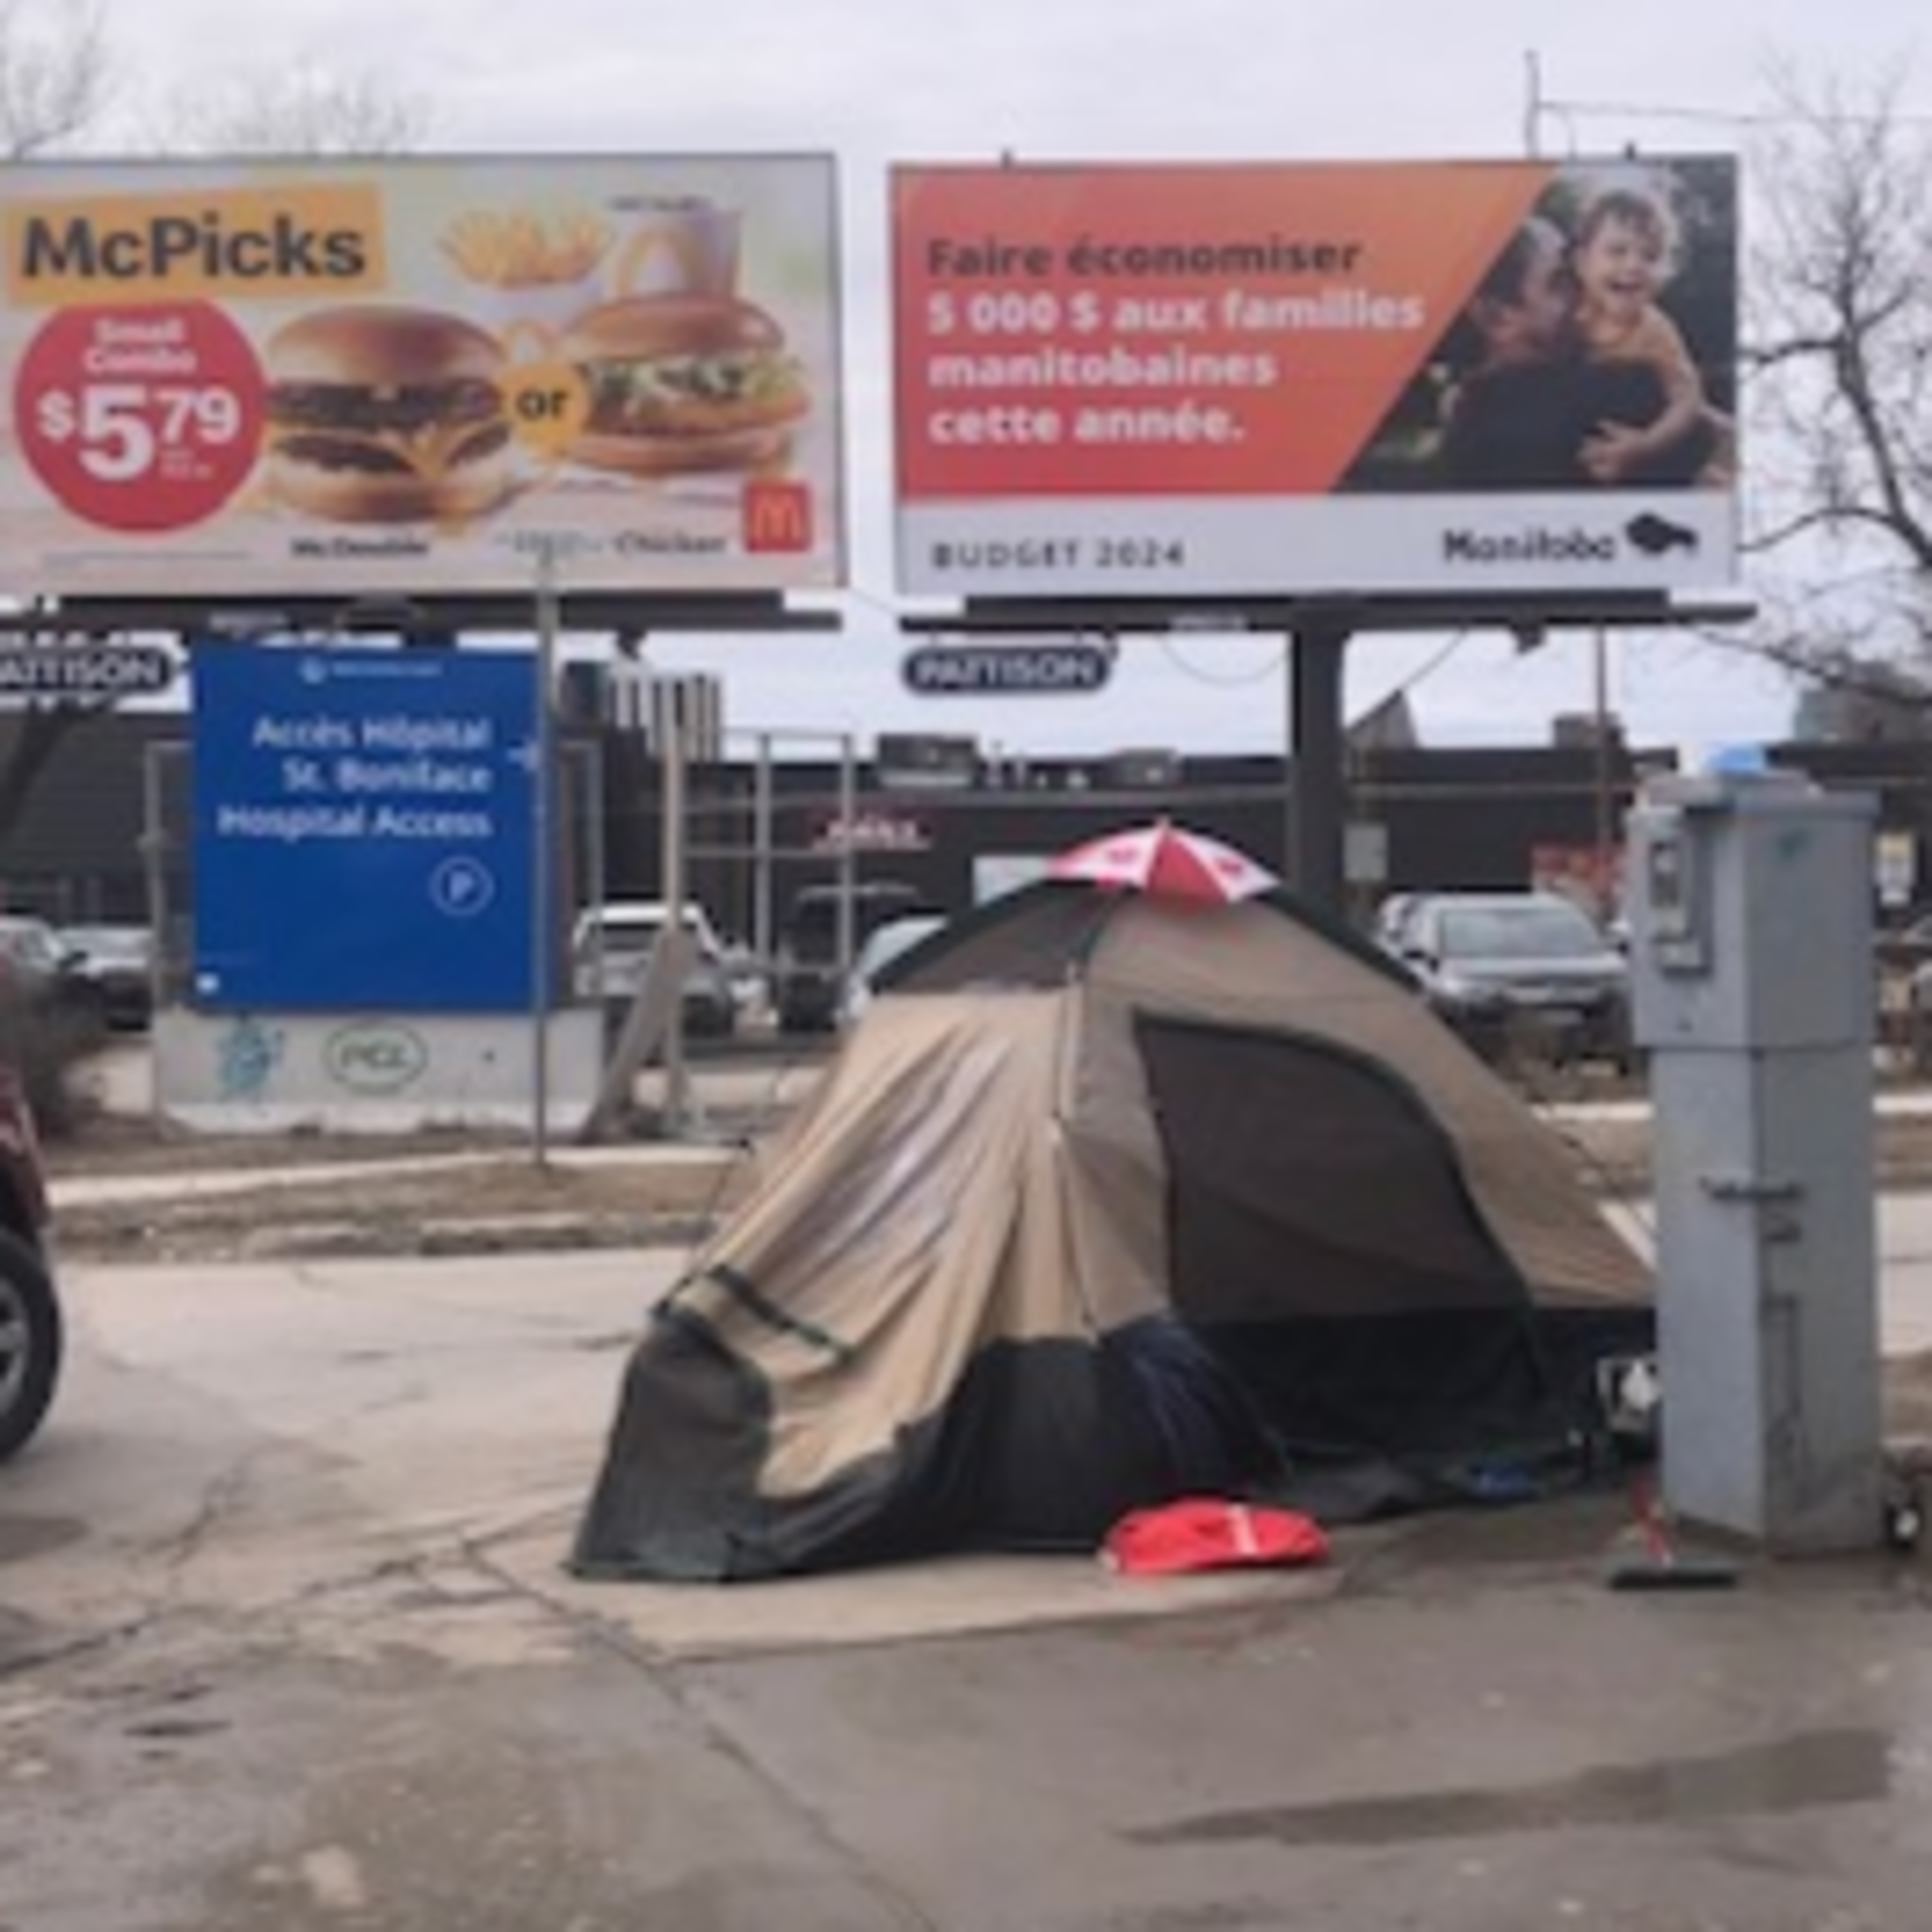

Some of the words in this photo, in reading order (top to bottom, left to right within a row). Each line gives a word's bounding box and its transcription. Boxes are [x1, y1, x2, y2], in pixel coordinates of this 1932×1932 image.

[21, 209, 367, 279] McPicks
[927, 240, 1052, 276] Faire
[1066, 236, 1361, 276] économiser
[928, 293, 953, 332] 5
[969, 294, 1057, 332] 000
[1113, 298, 1206, 331] aux
[1222, 289, 1425, 330] familles
[927, 348, 1276, 387] manitobaines
[517, 388, 568, 421] or
[928, 406, 1059, 444] cette
[1074, 404, 1245, 444] année.
[931, 544, 1081, 568] BUDGET
[1095, 542, 1185, 567] 2024
[1444, 530, 1615, 563] Manitoba
[0, 654, 160, 685] ATTISON
[916, 652, 1096, 689] PATTISON
[252, 716, 351, 750] Accès
[362, 716, 492, 755] Hôpital
[281, 760, 326, 792] St.
[338, 758, 492, 793] Boniface
[218, 806, 365, 842] Hospital
[372, 806, 491, 838] Access
